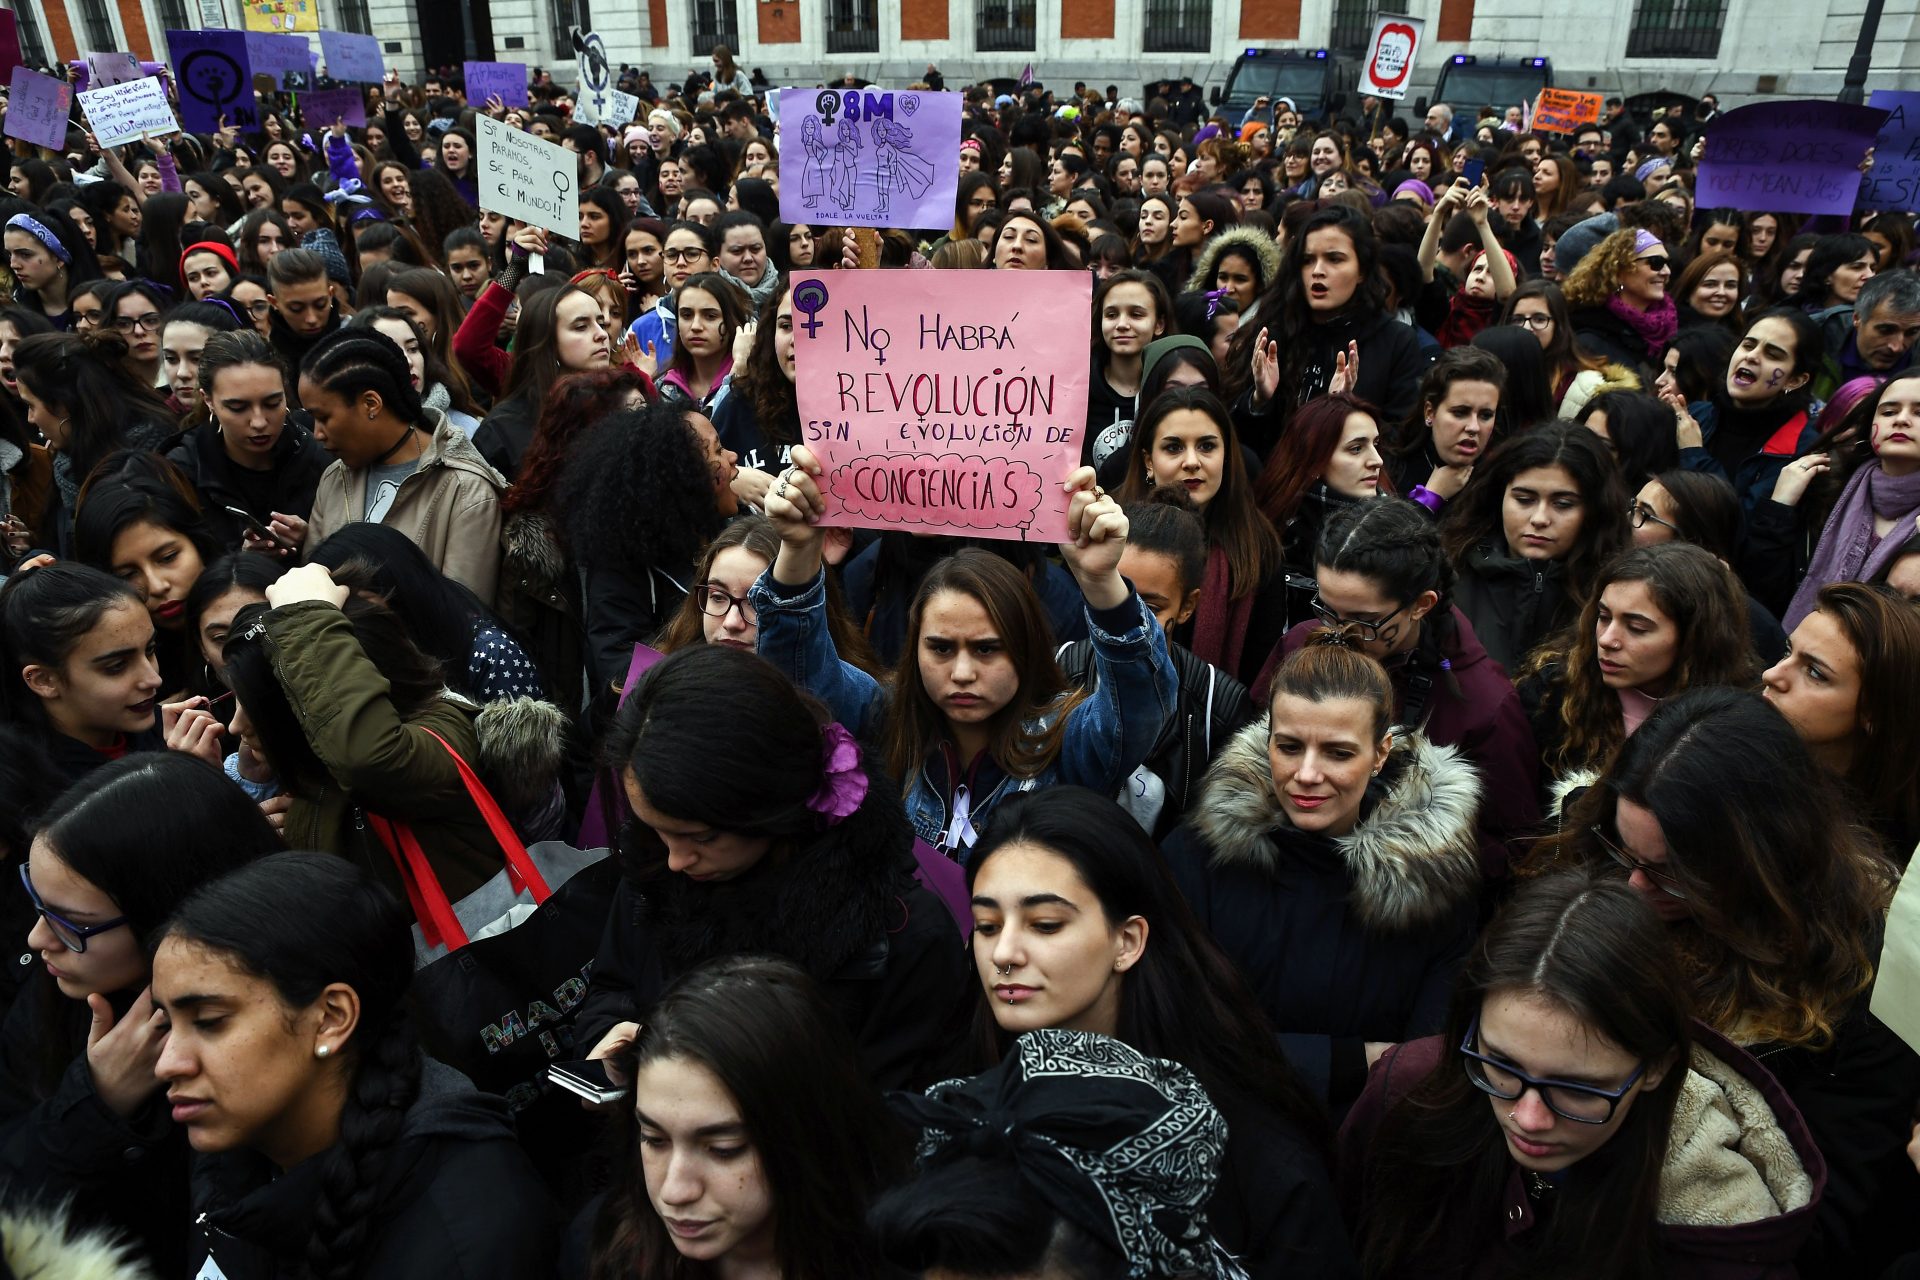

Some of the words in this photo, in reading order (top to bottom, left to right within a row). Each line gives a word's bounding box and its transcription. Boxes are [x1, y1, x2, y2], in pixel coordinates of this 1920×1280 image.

[844, 91, 894, 123] 8M
[505, 131, 552, 161] NOSOTRAS
[1779, 141, 1849, 163] DOES
[512, 168, 535, 186] PARA
[1747, 173, 1803, 195] MEAN
[844, 213, 853, 221] LA
[919, 311, 1020, 351] HABRÁ
[1046, 426, 1074, 443] DE
